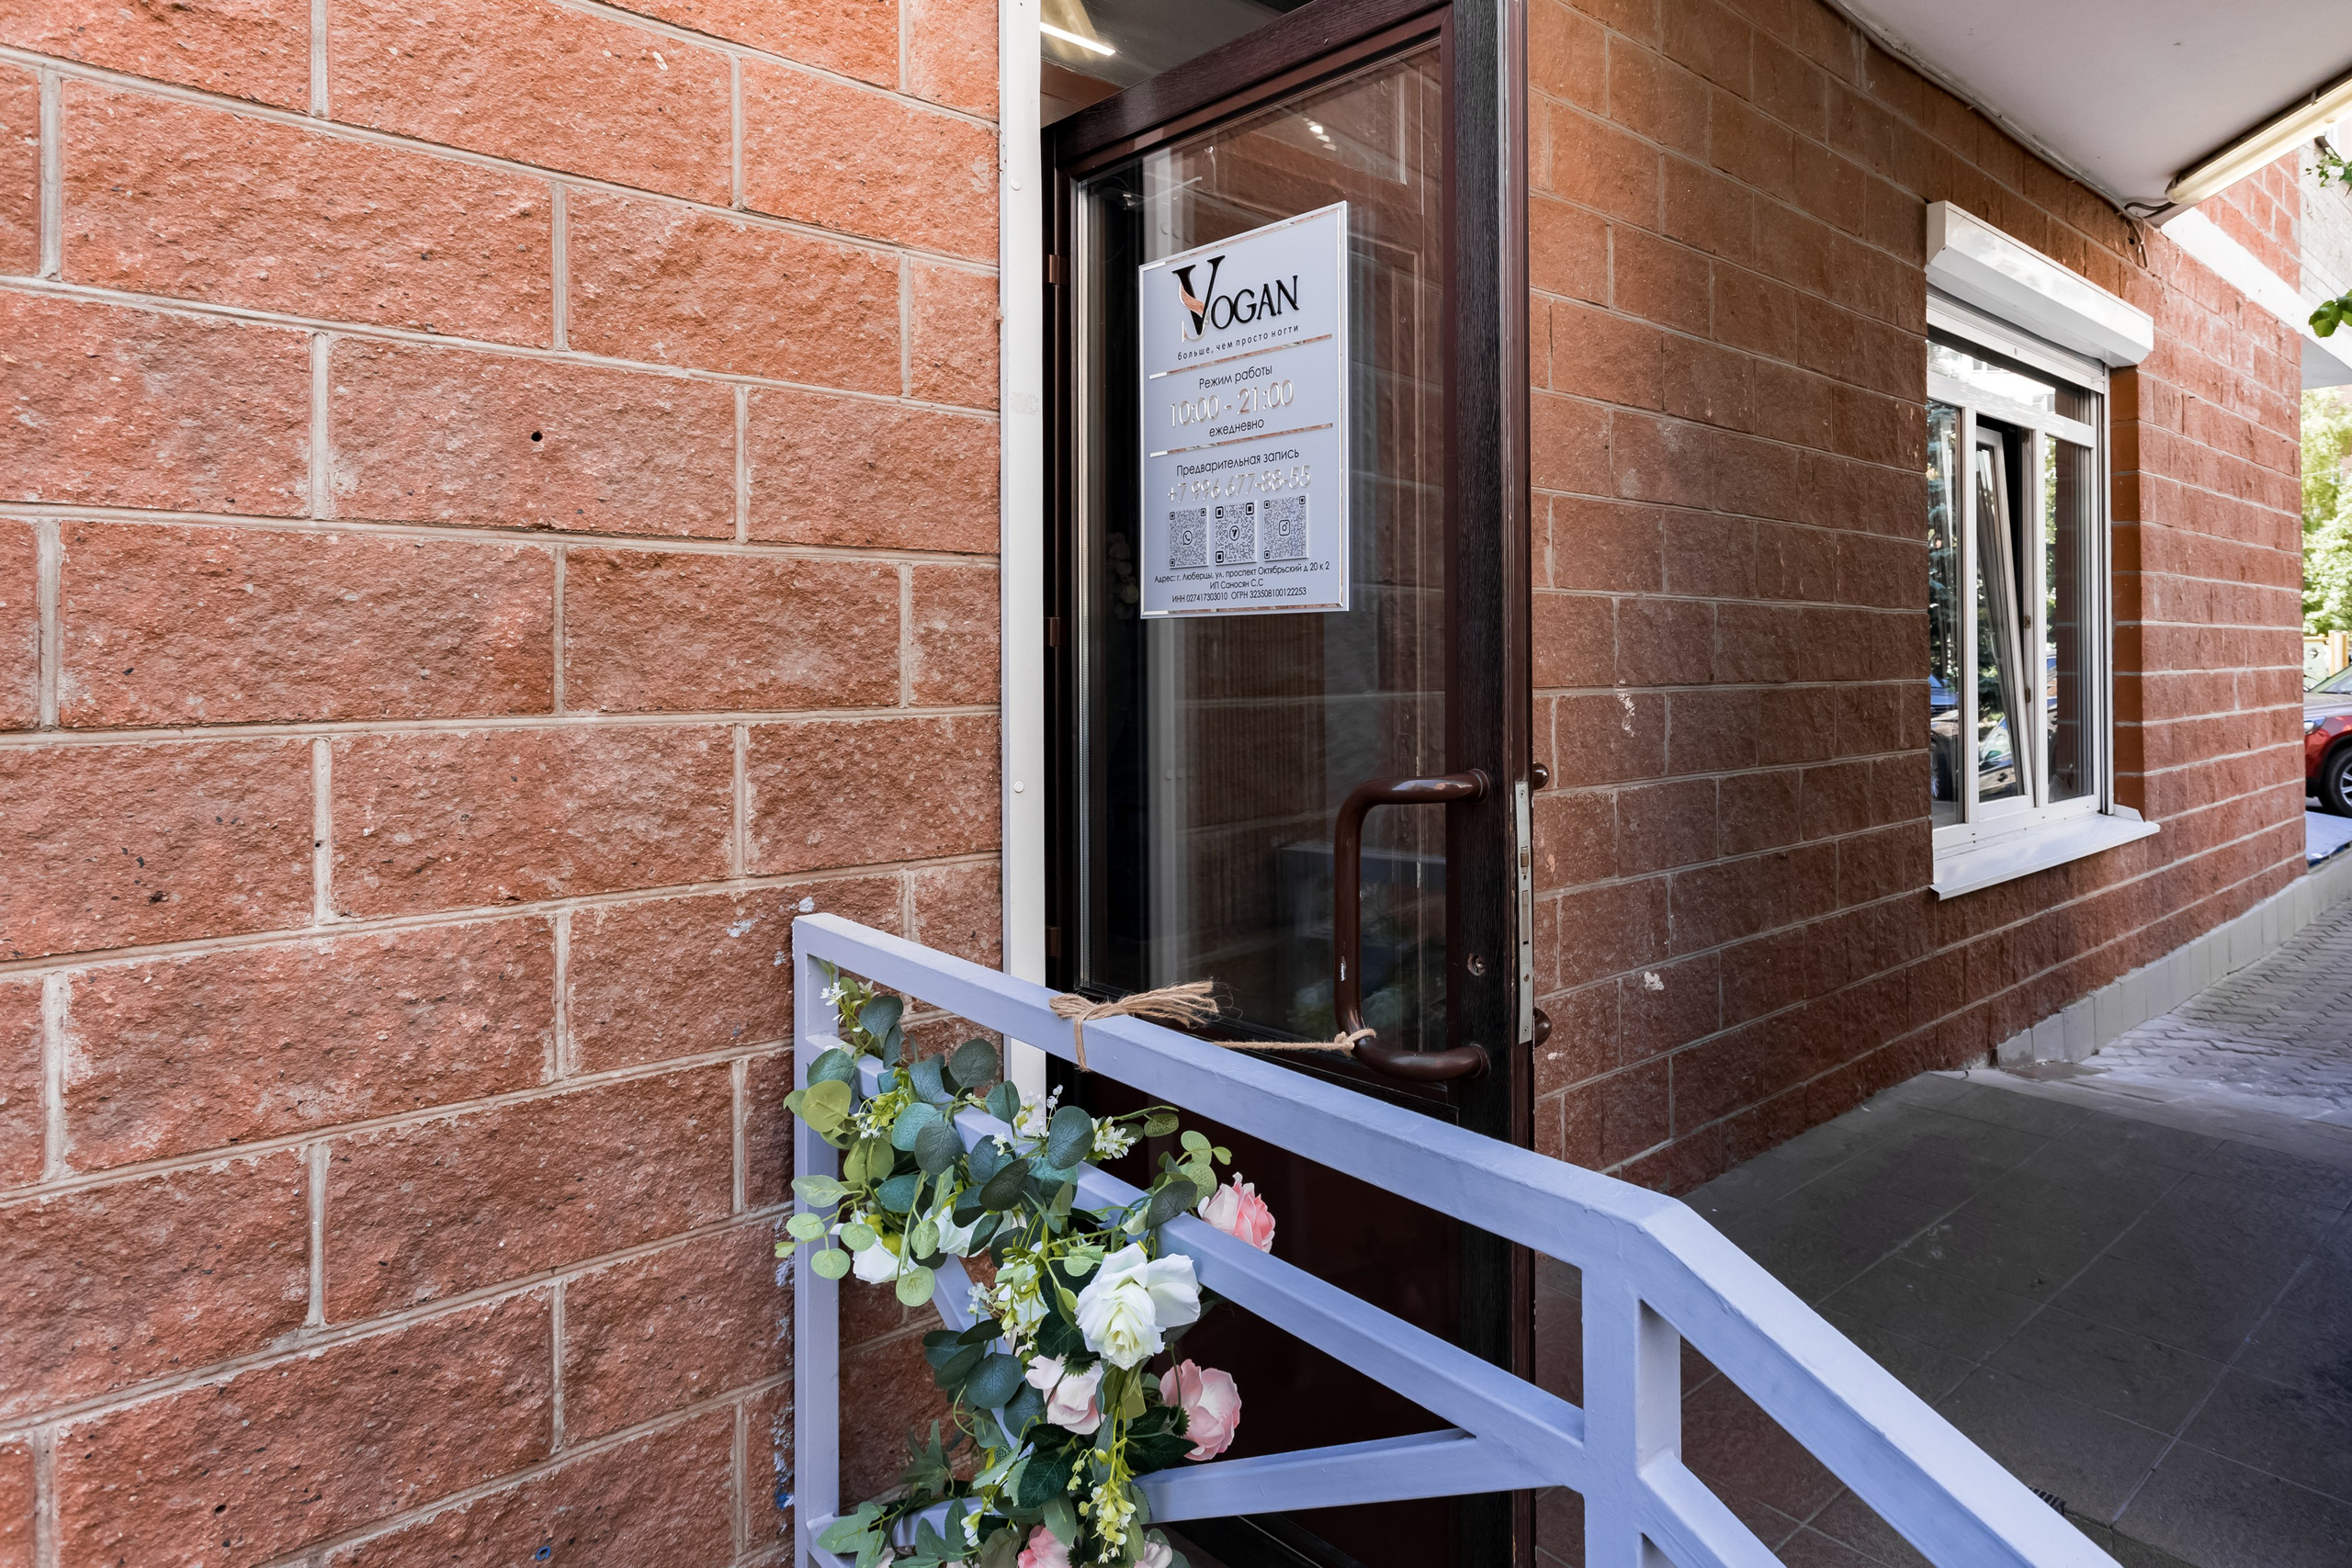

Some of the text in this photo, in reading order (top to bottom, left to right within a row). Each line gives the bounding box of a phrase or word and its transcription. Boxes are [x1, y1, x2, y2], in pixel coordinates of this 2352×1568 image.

[1171, 255, 1300, 336] VOGAN
[1177, 324, 1299, 361] больше, чем просто ногти
[1199, 366, 1272, 389] Режим работы
[1170, 394, 1220, 427] 10:00
[1237, 379, 1295, 415] 21:00
[1209, 418, 1265, 437] ежедневно
[1176, 448, 1300, 478] Предварительная запись
[1168, 465, 1311, 503] +7 996 677-88-55
[1154, 575, 1176, 583] Адрес:
[1182, 571, 1214, 581] Люберцы,
[1226, 568, 1257, 579] проспект
[1258, 563, 1302, 575] Октябрьский
[1309, 562, 1318, 571] 20
[1325, 561, 1330, 570] 2
[1171, 594, 1185, 603] ИНН
[1231, 591, 1249, 600] ОГРН
[1250, 587, 1307, 599] 323508100122253
[1209, 581, 1219, 590] ИП
[1220, 581, 1250, 590] Саносян
